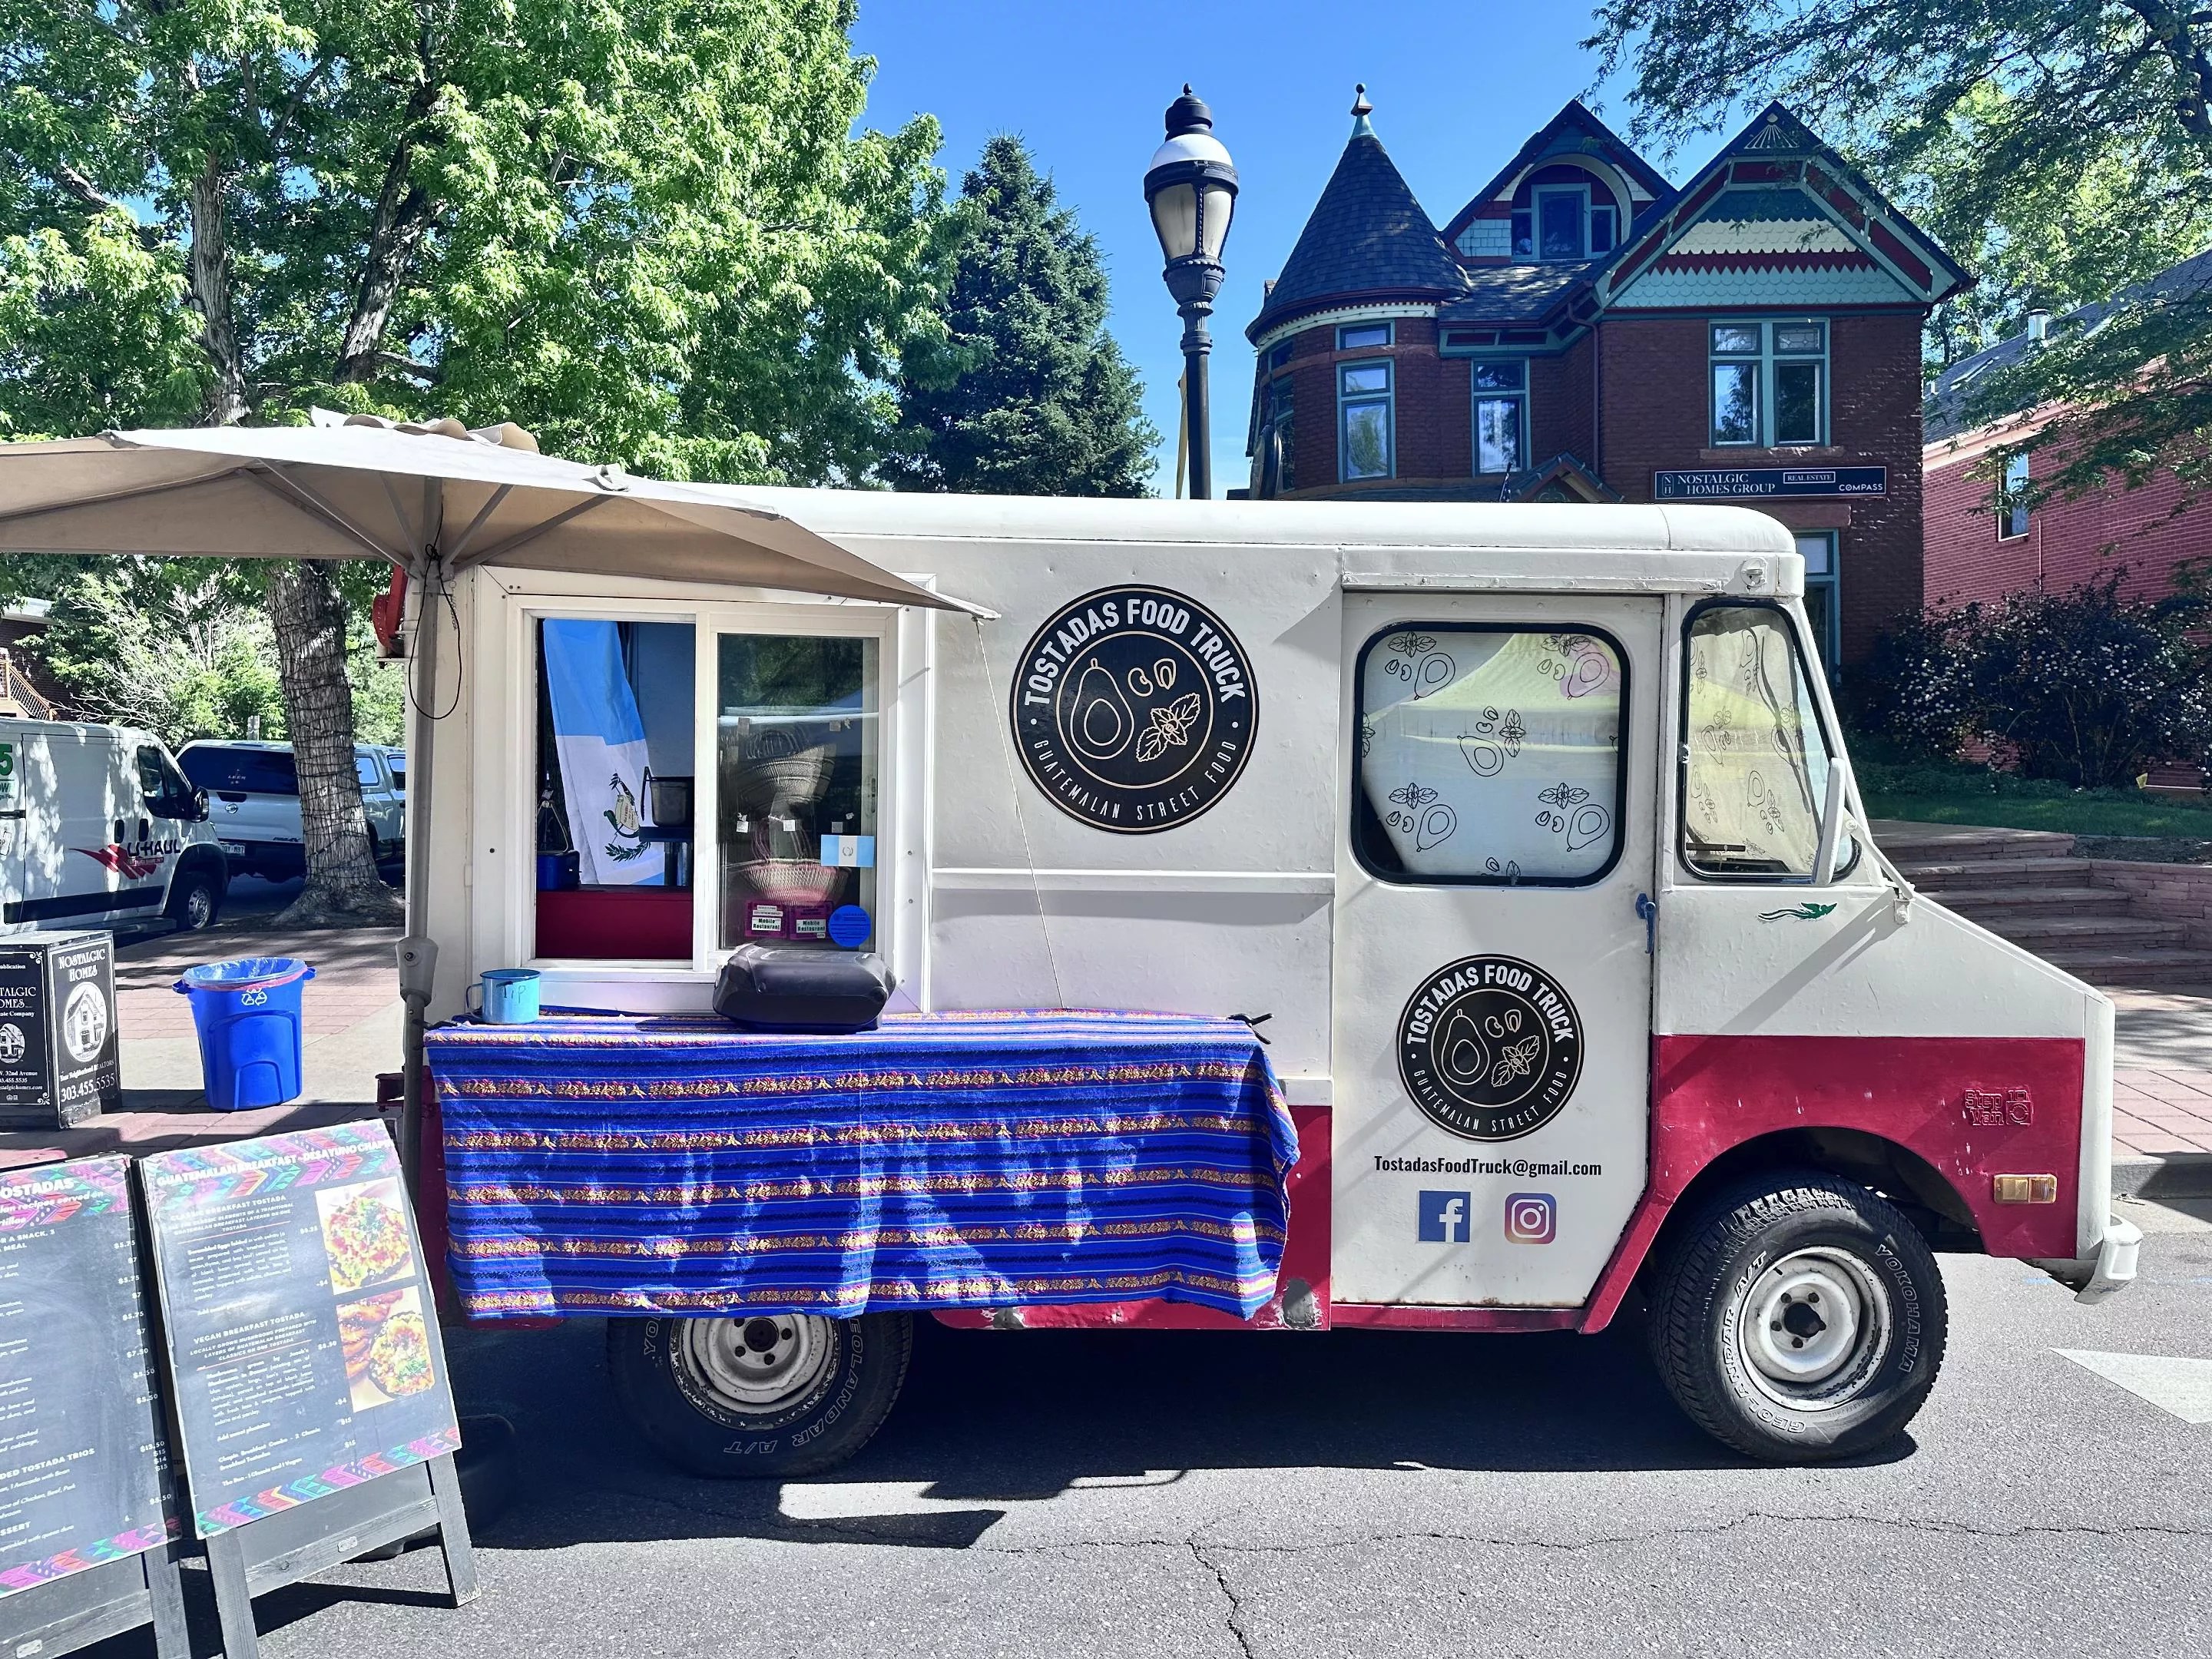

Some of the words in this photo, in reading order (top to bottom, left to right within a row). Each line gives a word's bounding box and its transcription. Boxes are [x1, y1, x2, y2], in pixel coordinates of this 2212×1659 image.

[1677, 473, 1749, 485] NOSTALGIC
[1687, 485, 1730, 495] HOMES
[1733, 483, 1776, 493] GROUP
[1839, 483, 1883, 492] COMPASS
[1024, 601, 1120, 706] TOSTADAS
[1127, 599, 1190, 634] FOOD
[1190, 622, 1246, 703] TRUCK
[1033, 740, 1121, 820] GUATEMALAN
[1137, 785, 1200, 820] STREET
[1204, 741, 1237, 783] FOOD
[127, 839, 181, 857] U-HAUL
[58, 949, 106, 969] NOSTALGIC
[69, 965, 98, 982] HOMES
[1406, 966, 1479, 1045] TOSTADAS
[1485, 965, 1533, 992] FOOD
[1532, 982, 1575, 1043] TRUCK
[61, 1073, 115, 1103] 303.455.5535
[1413, 1069, 1480, 1131] GUATEMALAN
[1492, 1105, 1540, 1132] STREET
[1542, 1071, 1567, 1104] FOOD
[1965, 1089, 2002, 1111] Step
[1970, 1108, 2005, 1126] Van
[237, 1154, 297, 1172] BREAKFAST
[1373, 1155, 1602, 1178] TostadasFoodTruck@gmail.com
[0, 1177, 75, 1197] OSTADAS
[17, 1198, 55, 1210] recipes
[57, 1192, 89, 1204] served
[206, 1202, 250, 1214] BREAKFAST
[252, 1195, 286, 1205] TOSTADA
[1874, 1243, 1920, 1373] YOKOHAMA
[194, 1333, 221, 1343] VEGAN
[223, 1322, 268, 1336] BREAKFAST
[270, 1312, 305, 1324] TOSTADA
[190, 1346, 215, 1355] LOCALLY
[204, 1349, 226, 1358] LAYERS
[219, 1350, 246, 1360] CLASSICS
[270, 1338, 293, 1346] TOSTADA
[791, 1319, 864, 1448] EOLANDAR
[22, 1457, 65, 1472] TOSTADA
[67, 1448, 94, 1460] TRIOS
